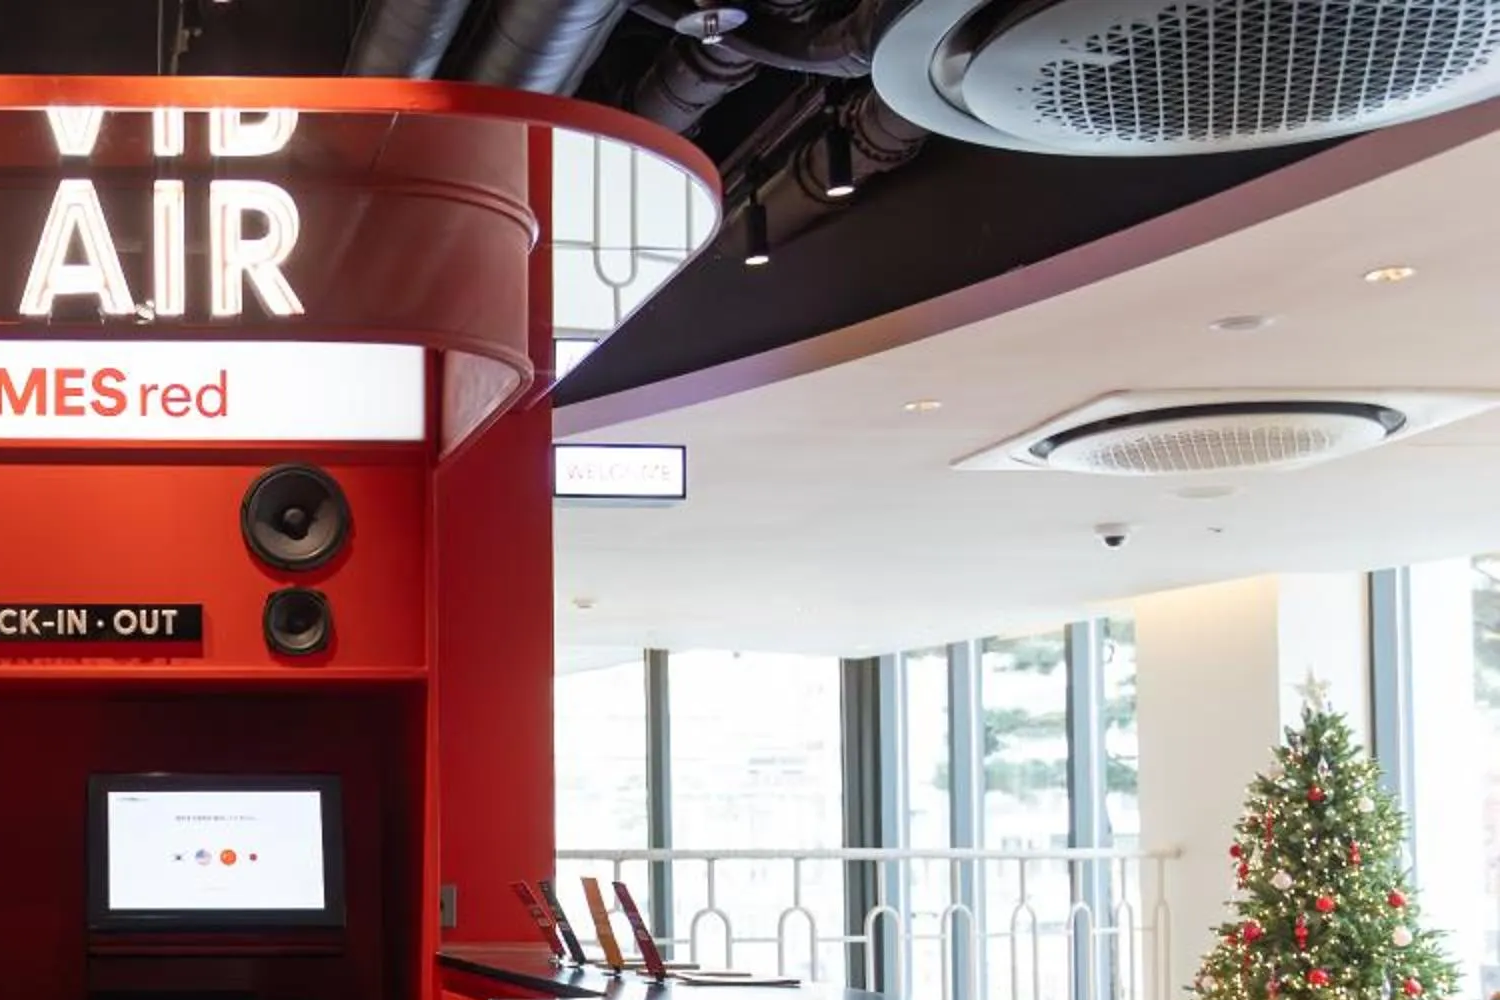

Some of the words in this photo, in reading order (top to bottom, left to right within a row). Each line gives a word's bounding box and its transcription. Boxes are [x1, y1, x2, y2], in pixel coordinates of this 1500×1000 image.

[19, 178, 304, 315] AIR
[139, 369, 228, 418] red
[113, 608, 178, 635] OUT
